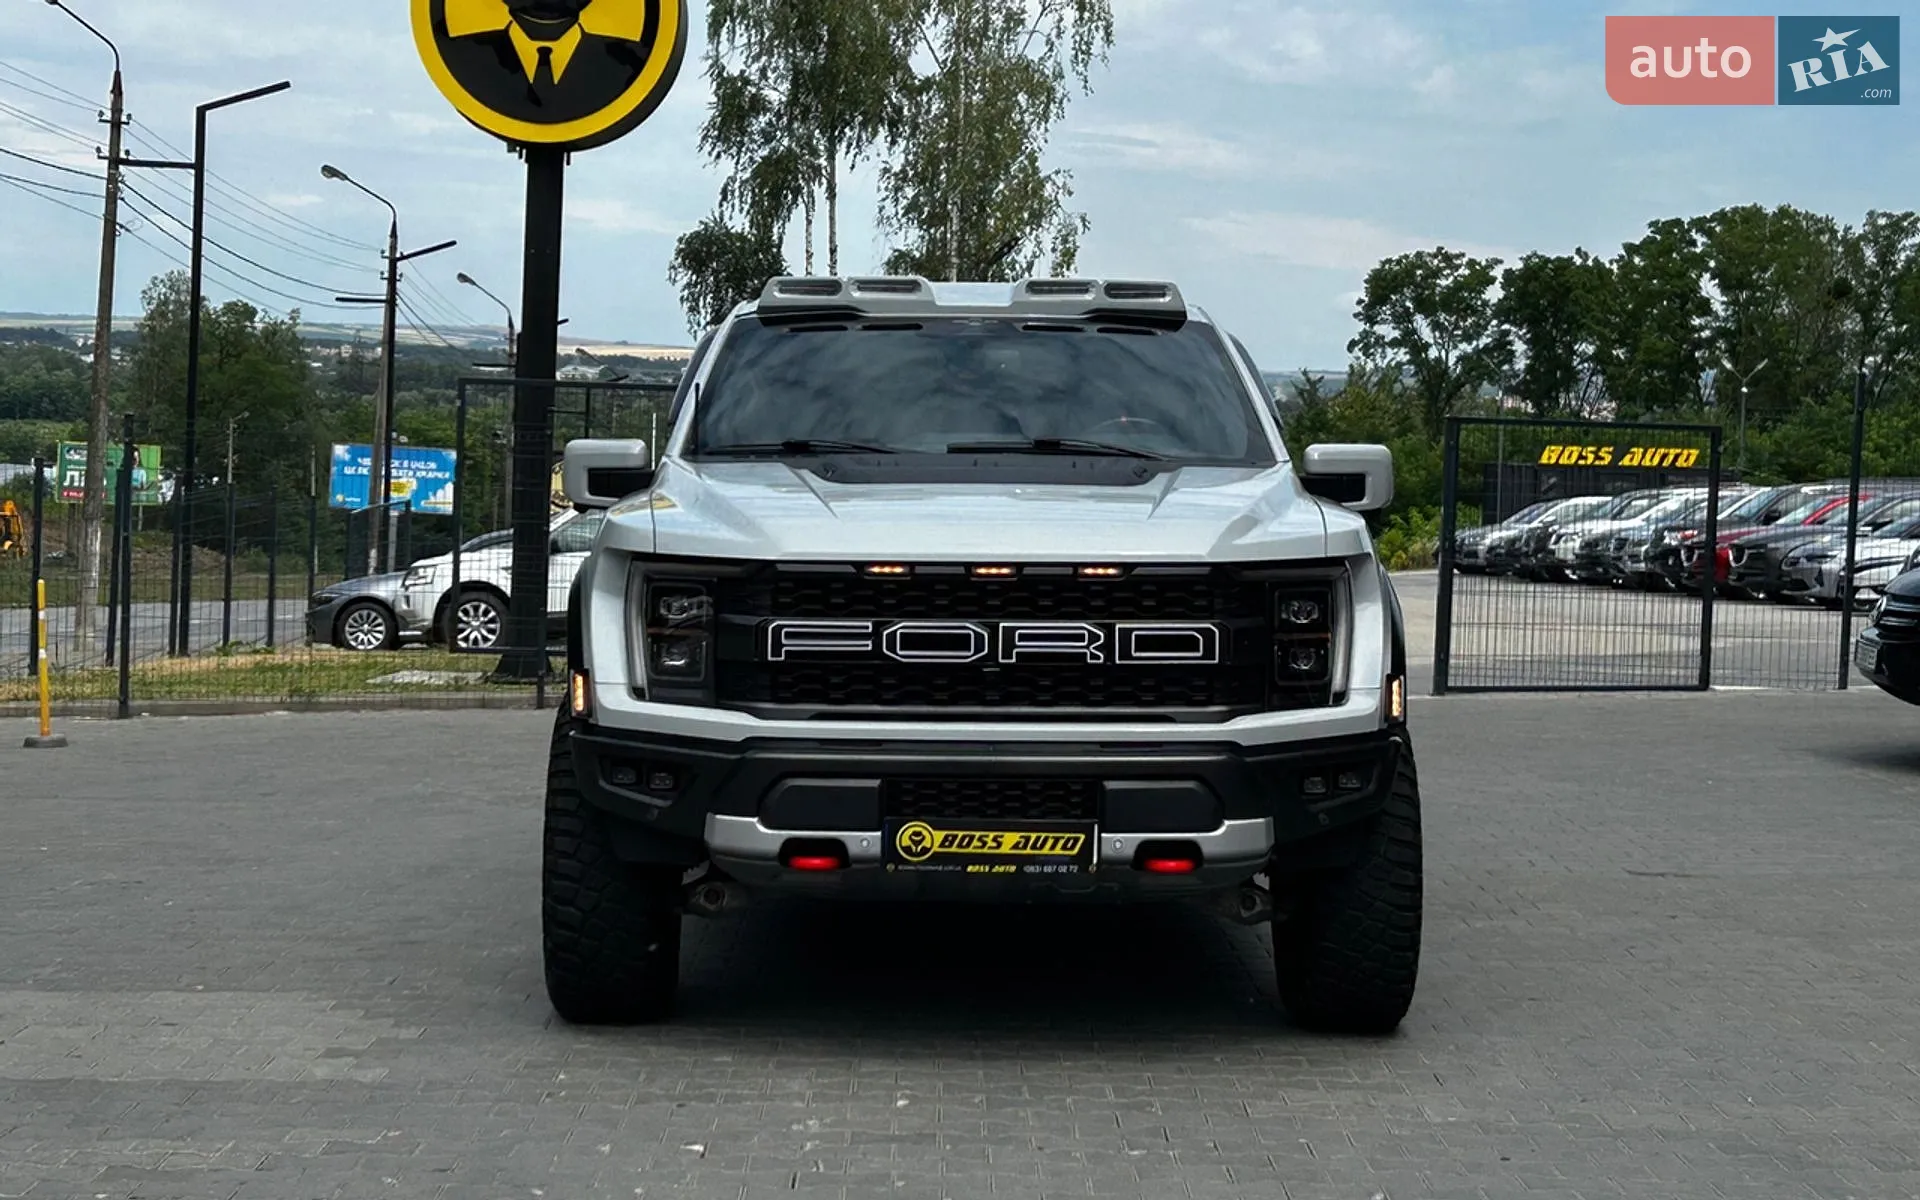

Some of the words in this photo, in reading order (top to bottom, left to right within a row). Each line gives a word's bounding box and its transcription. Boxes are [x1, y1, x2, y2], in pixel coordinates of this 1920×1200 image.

[1538, 445, 1614, 465] BOSS
[1618, 447, 1700, 468] AUTO
[767, 620, 1219, 664] FORD
[938, 833, 1005, 850] BOSS
[1009, 834, 1081, 851] AUTO
[966, 864, 990, 873] BOSS
[992, 864, 1017, 873] AUTO
